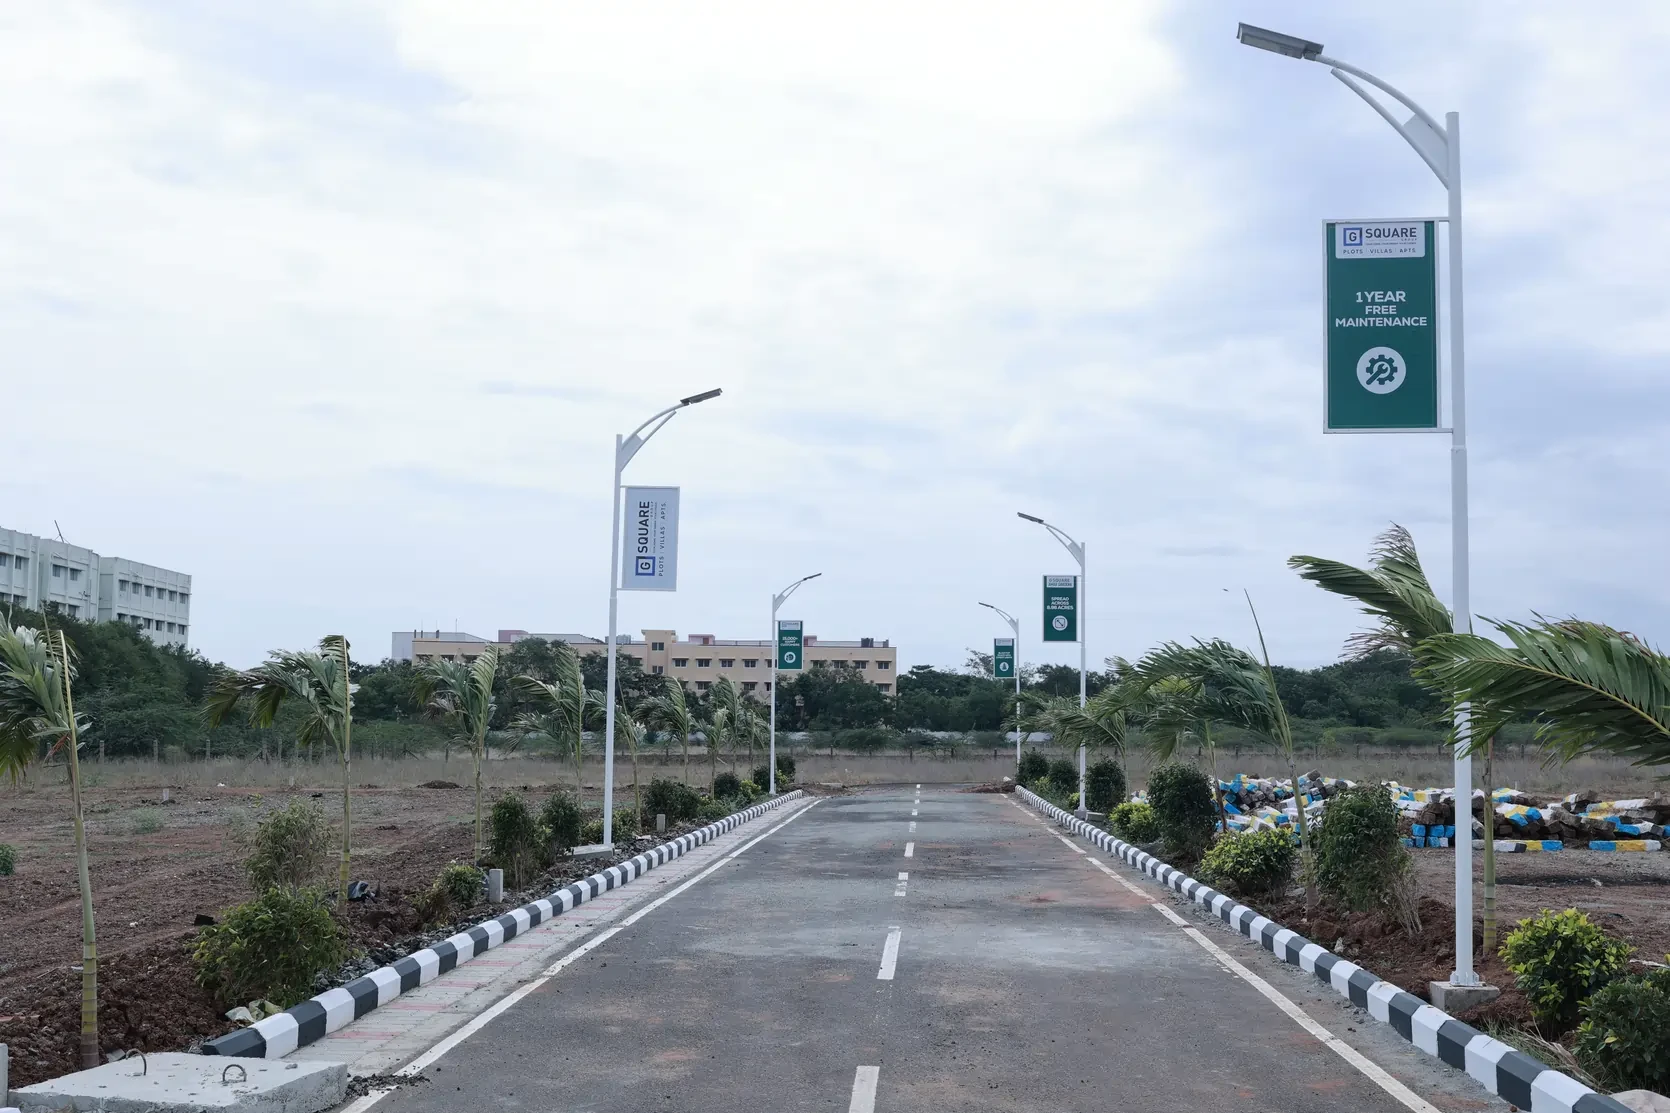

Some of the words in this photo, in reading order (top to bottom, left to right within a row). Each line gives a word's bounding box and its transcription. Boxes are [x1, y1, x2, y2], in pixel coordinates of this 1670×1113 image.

[1348, 232, 1357, 242] G
[1365, 227, 1417, 238] SQUARE
[1356, 292, 1363, 302] 1
[1364, 290, 1406, 302] YEAR
[1365, 305, 1397, 314] FREE
[1335, 316, 1428, 328] MAINTENANCE
[638, 501, 650, 554] SQUARE
[640, 562, 651, 571] G
